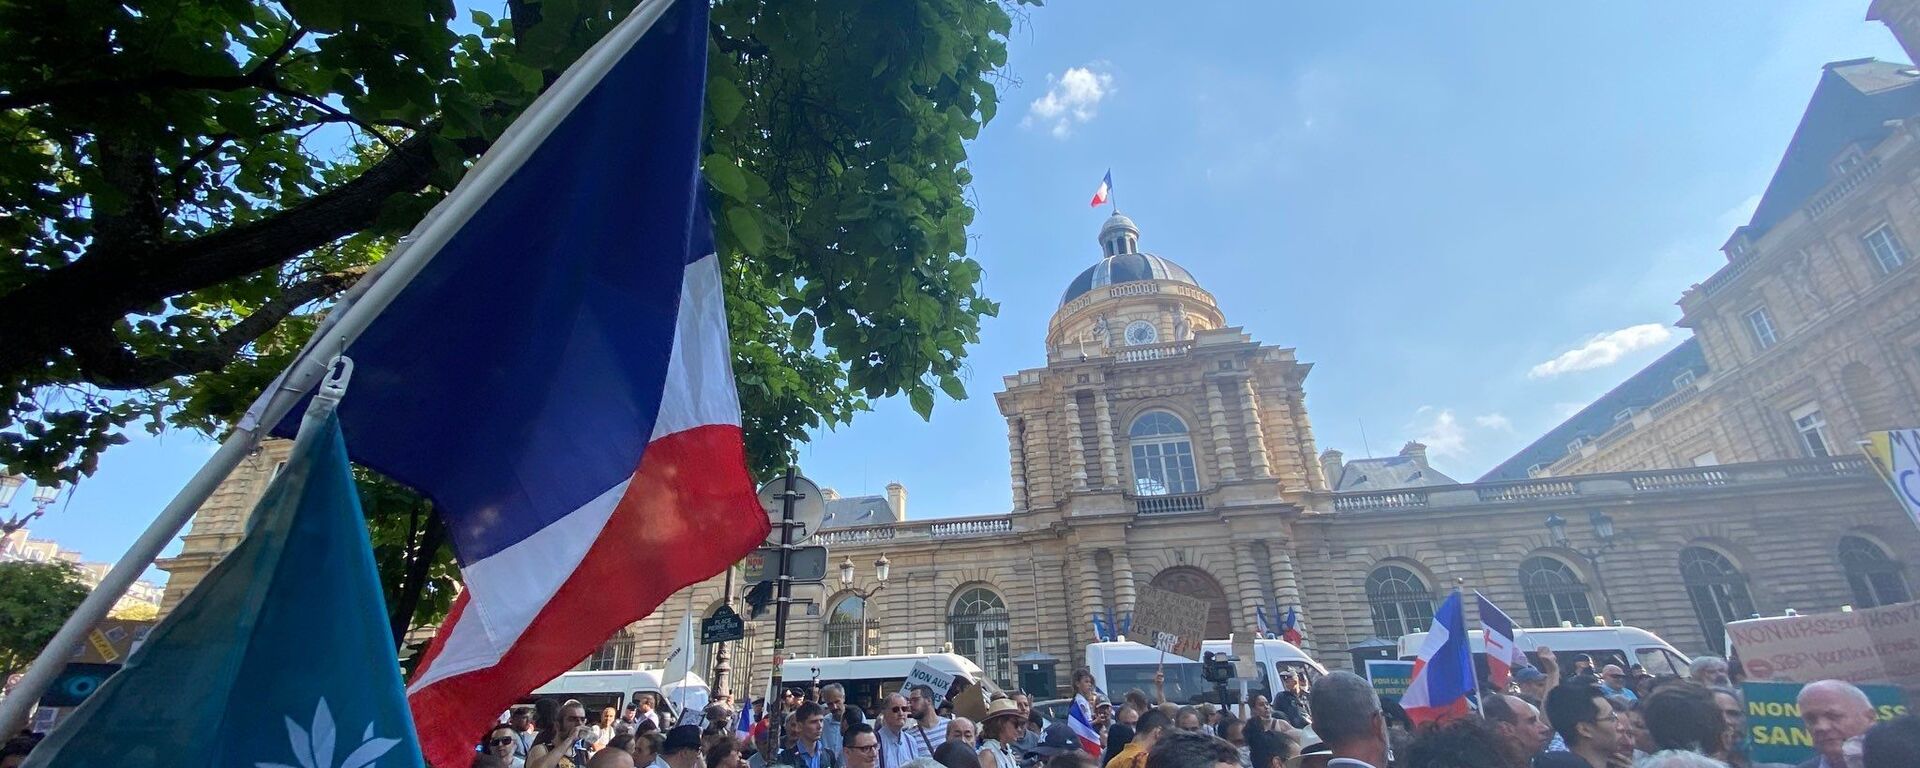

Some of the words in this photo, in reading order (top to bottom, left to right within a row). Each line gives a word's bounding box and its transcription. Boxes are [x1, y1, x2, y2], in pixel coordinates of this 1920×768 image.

[1733, 624, 1783, 646] NON
[911, 669, 932, 682] NON
[931, 677, 950, 690] AUX
[1749, 702, 1801, 717] NON
